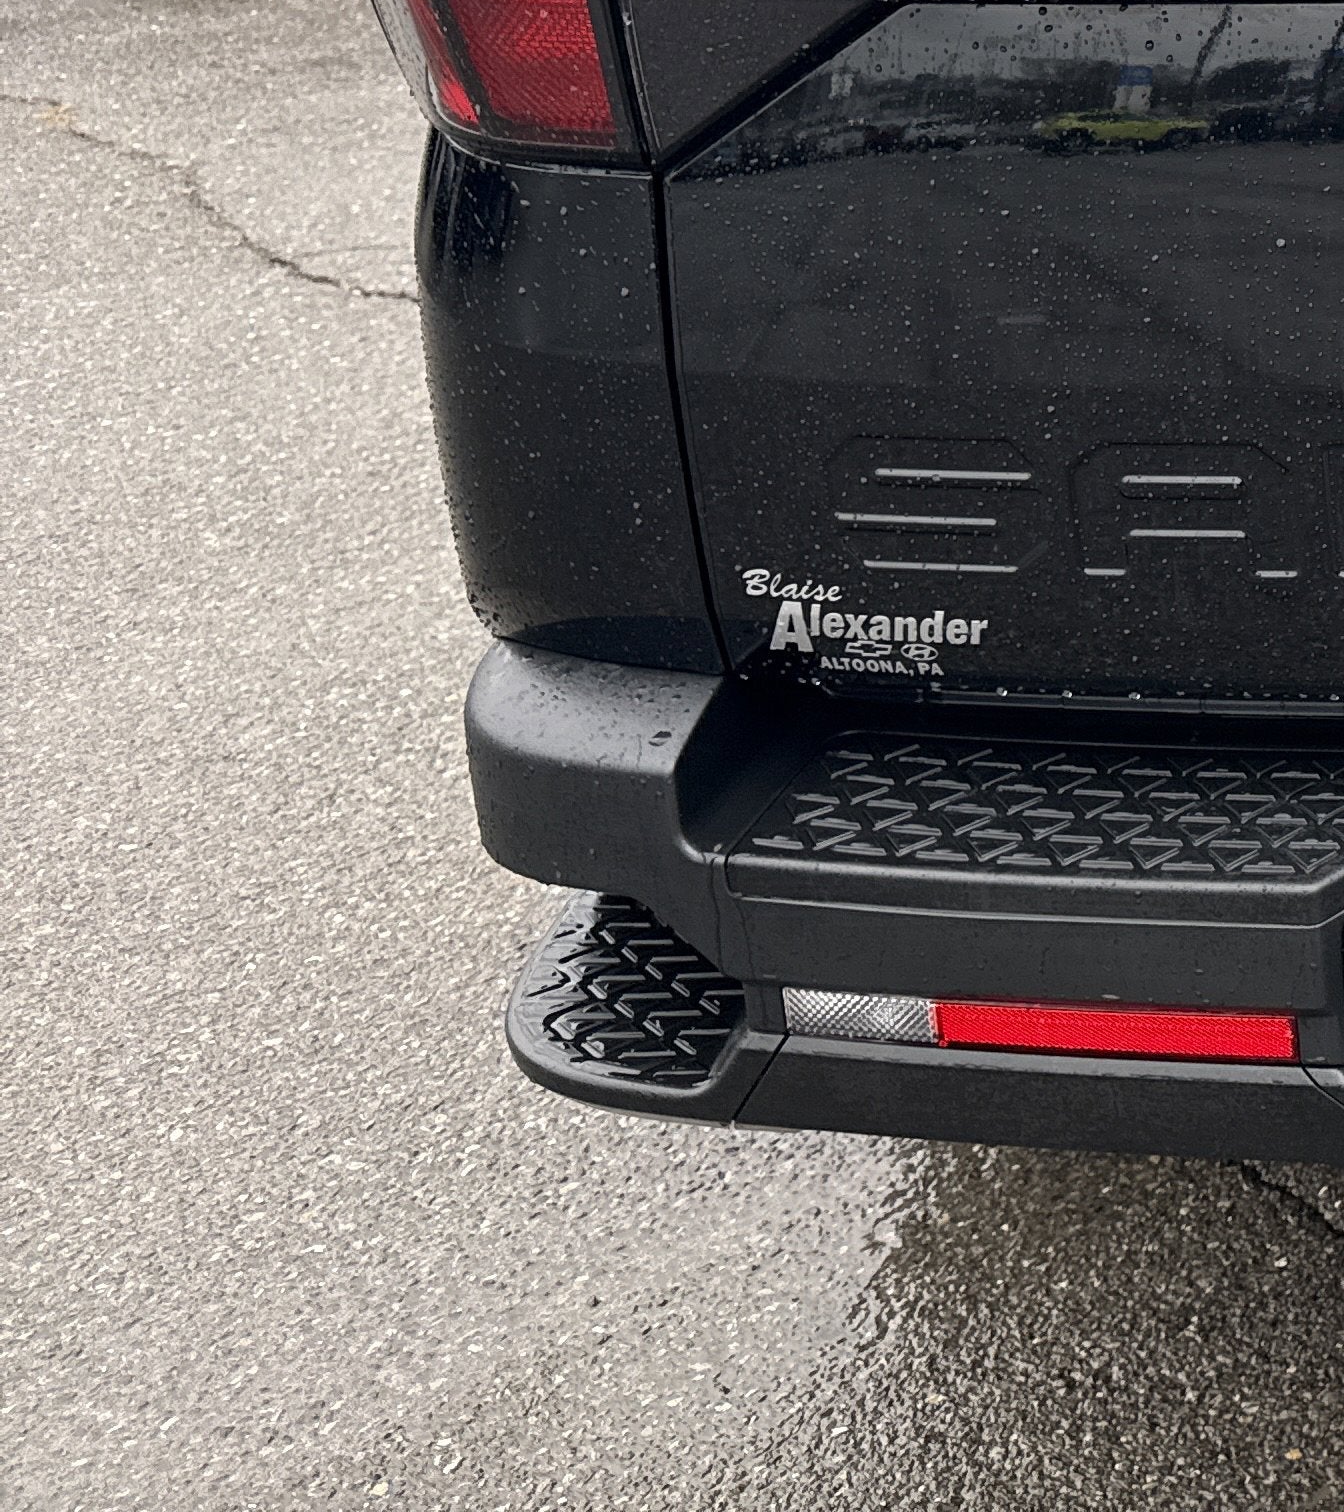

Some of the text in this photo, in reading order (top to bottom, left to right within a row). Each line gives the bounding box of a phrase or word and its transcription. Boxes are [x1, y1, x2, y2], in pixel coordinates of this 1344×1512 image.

[742, 568, 843, 602] Blaise
[769, 600, 989, 653] Alexander
[820, 656, 944, 676] ALTOONA, PA
